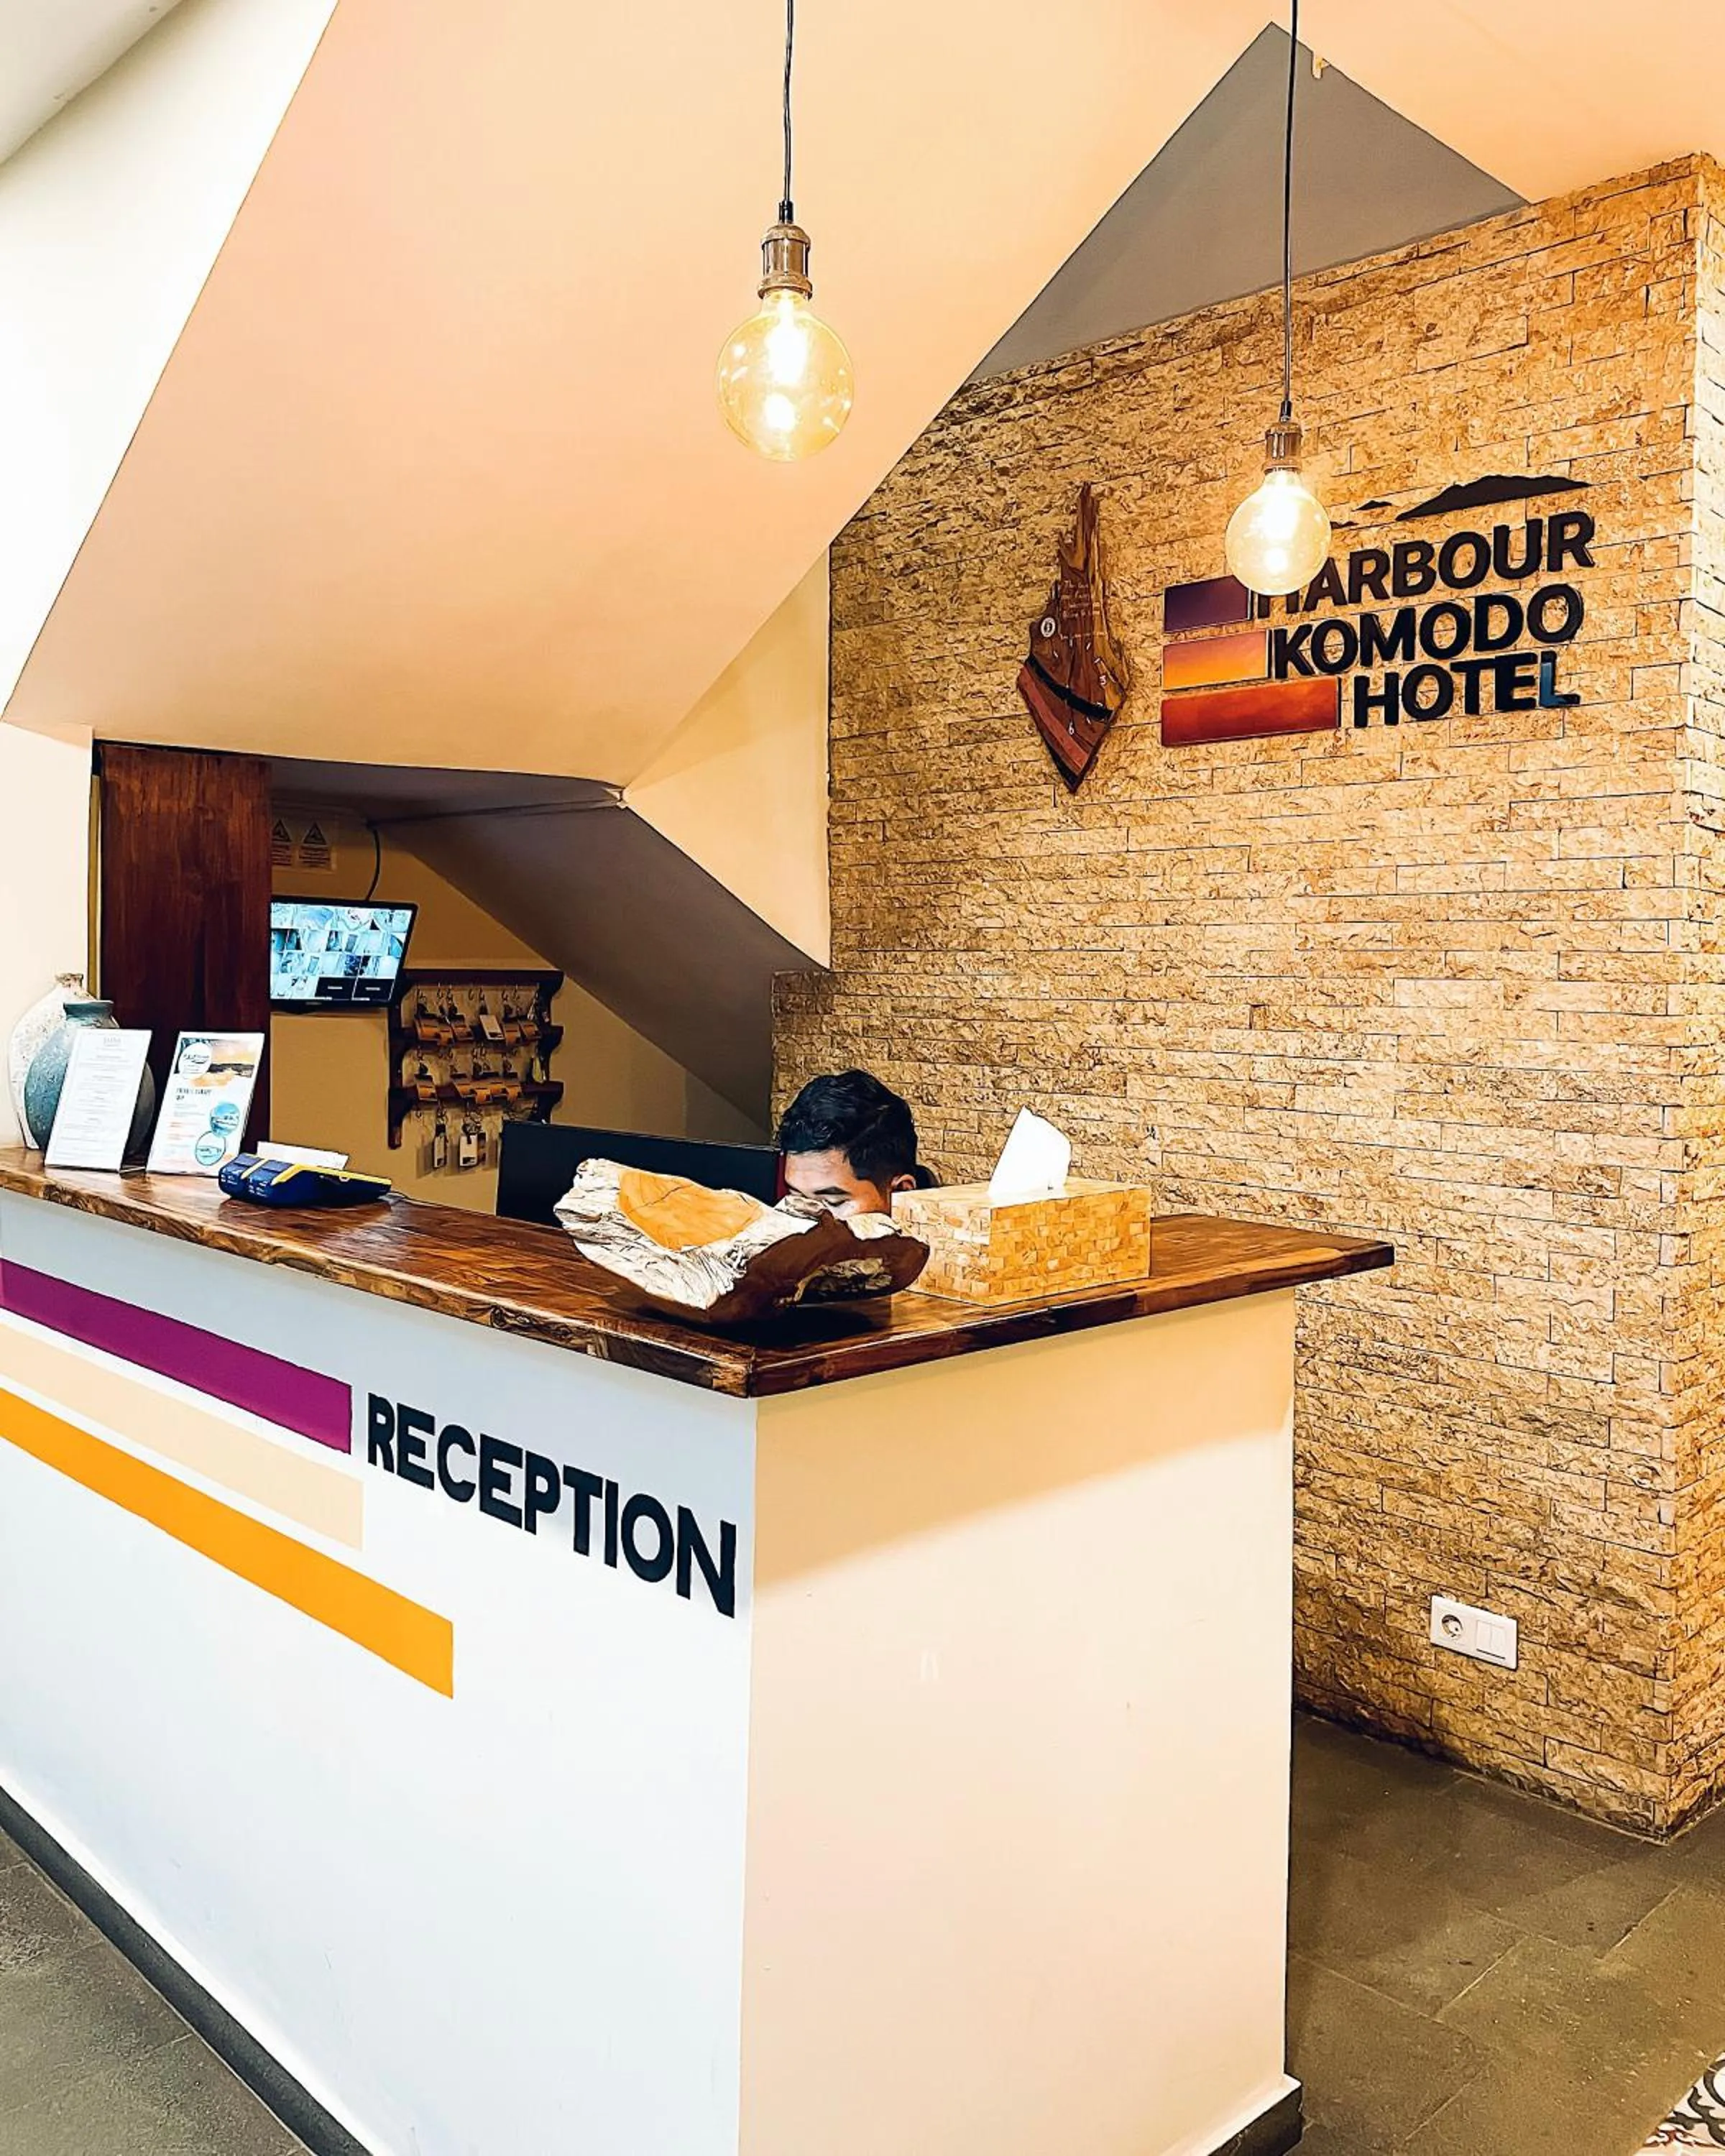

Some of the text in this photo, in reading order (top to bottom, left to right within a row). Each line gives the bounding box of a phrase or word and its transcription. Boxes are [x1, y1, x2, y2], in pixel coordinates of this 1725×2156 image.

[1274, 584, 1583, 678] KOMODO
[1354, 651, 1580, 729] HOTEL
[368, 1393, 736, 1618] RECEPTION
